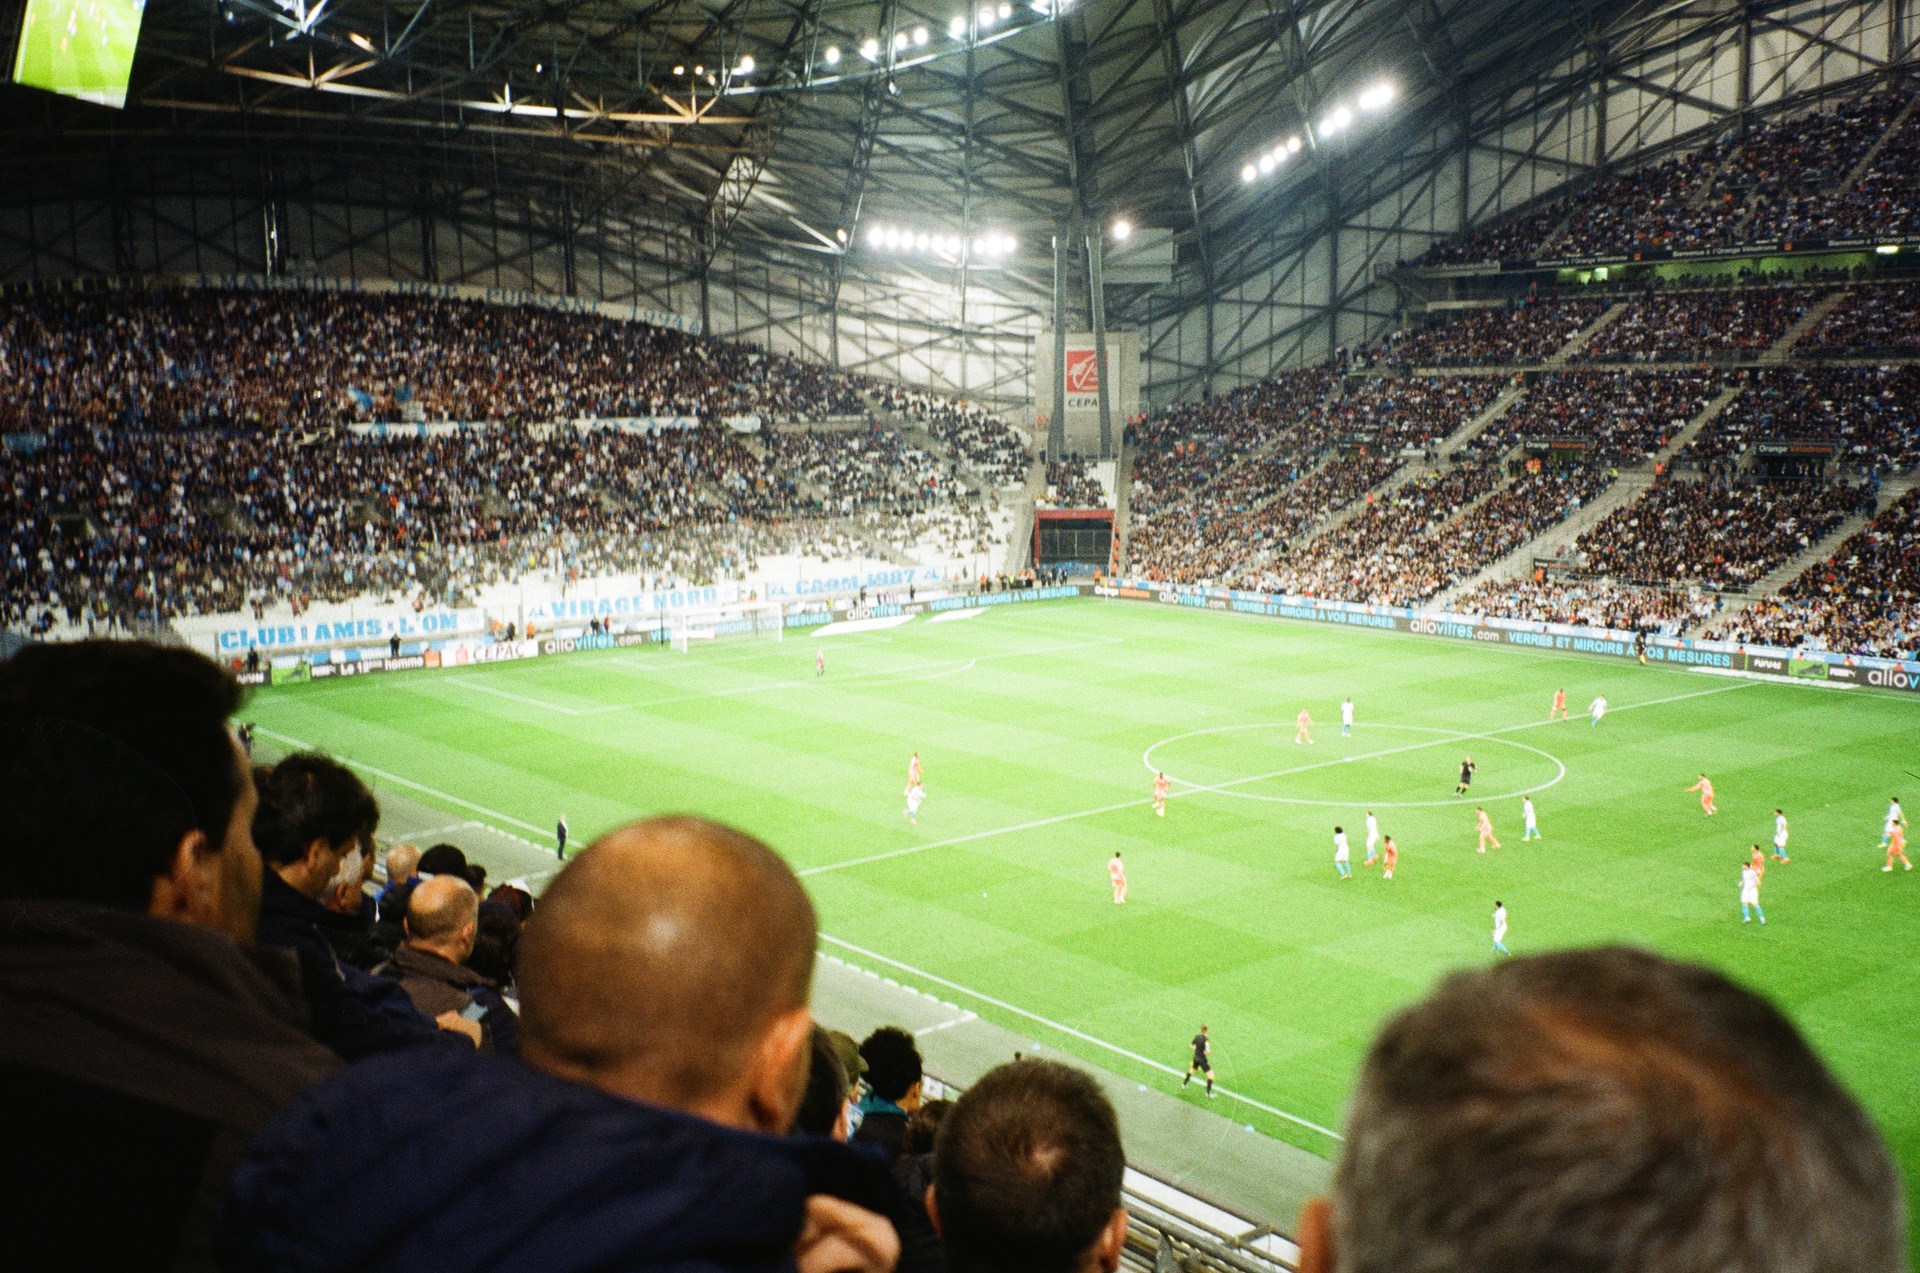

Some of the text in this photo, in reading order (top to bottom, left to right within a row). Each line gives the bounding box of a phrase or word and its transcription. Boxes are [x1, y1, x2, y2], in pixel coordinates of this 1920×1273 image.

[1068, 399, 1098, 408] CEPA
[1759, 445, 1788, 454] Orange
[551, 587, 718, 618] VIRAGE NORD
[1232, 600, 1265, 614] VERRES
[1280, 604, 1317, 620] MIROIRS
[1327, 611, 1347, 624] VOS
[1349, 613, 1394, 629] MESURES
[220, 625, 296, 649] CLUB
[314, 618, 382, 641] AMIS
[1410, 618, 1499, 641] allovitres.com
[473, 641, 526, 663] CEPAC
[544, 633, 642, 655] allovitres.com
[1509, 630, 1553, 648] VERRES
[1556, 636, 1570, 649] ET
[1574, 639, 1623, 655] MIROIRS
[1668, 650, 1731, 668] MESURES
